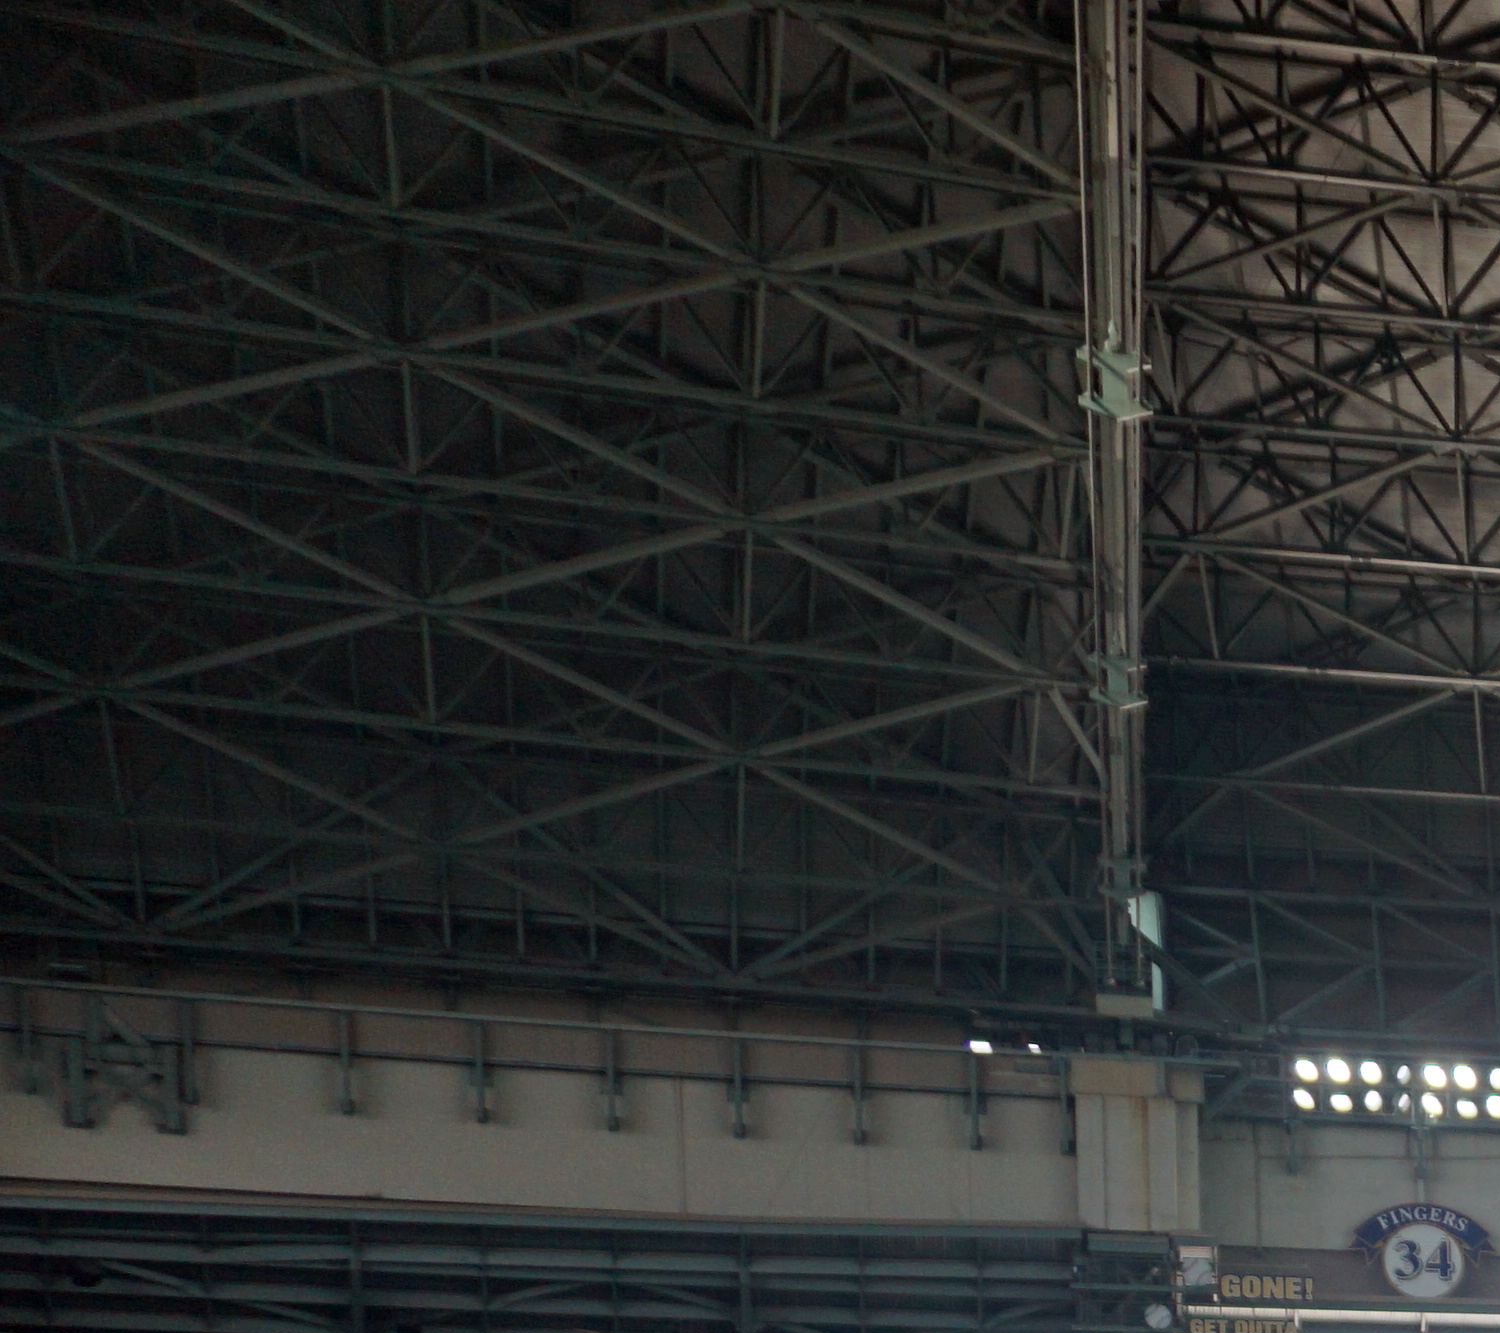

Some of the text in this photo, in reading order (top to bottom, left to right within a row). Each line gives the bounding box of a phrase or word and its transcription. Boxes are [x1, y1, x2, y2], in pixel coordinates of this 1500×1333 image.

[1375, 1203, 1471, 1235] FINGERS
[1393, 1240, 1454, 1283] 34
[1220, 1274, 1313, 1300] GONE!
